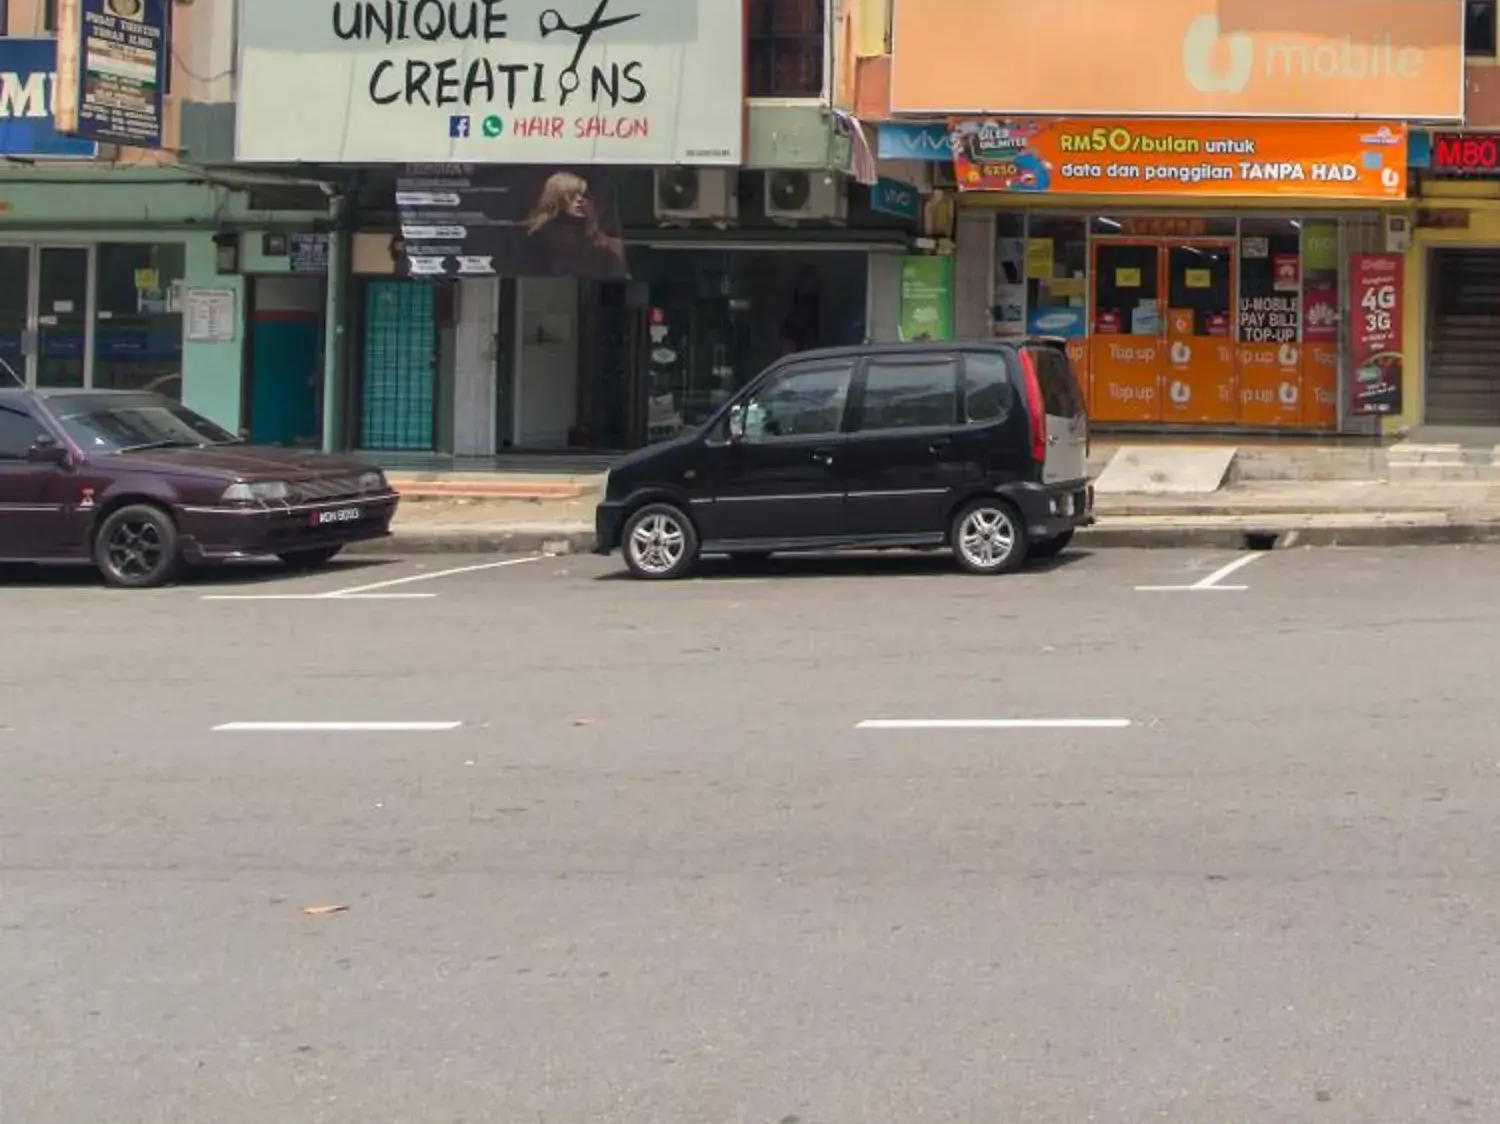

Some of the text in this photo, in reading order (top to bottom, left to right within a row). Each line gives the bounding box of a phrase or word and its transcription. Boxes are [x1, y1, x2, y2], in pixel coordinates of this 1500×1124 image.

[1266, 33, 1424, 80] mobile
[513, 114, 649, 138] HAIR SALON
[1060, 128, 1255, 154] RM50/bulan untuk
[1061, 162, 1361, 182] data dan panggilan TANPA HAD.
[1361, 286, 1396, 310] 4G
[1240, 313, 1266, 327] PAY
[1365, 313, 1391, 331] 3G
[1245, 328, 1294, 343] TOP-UP
